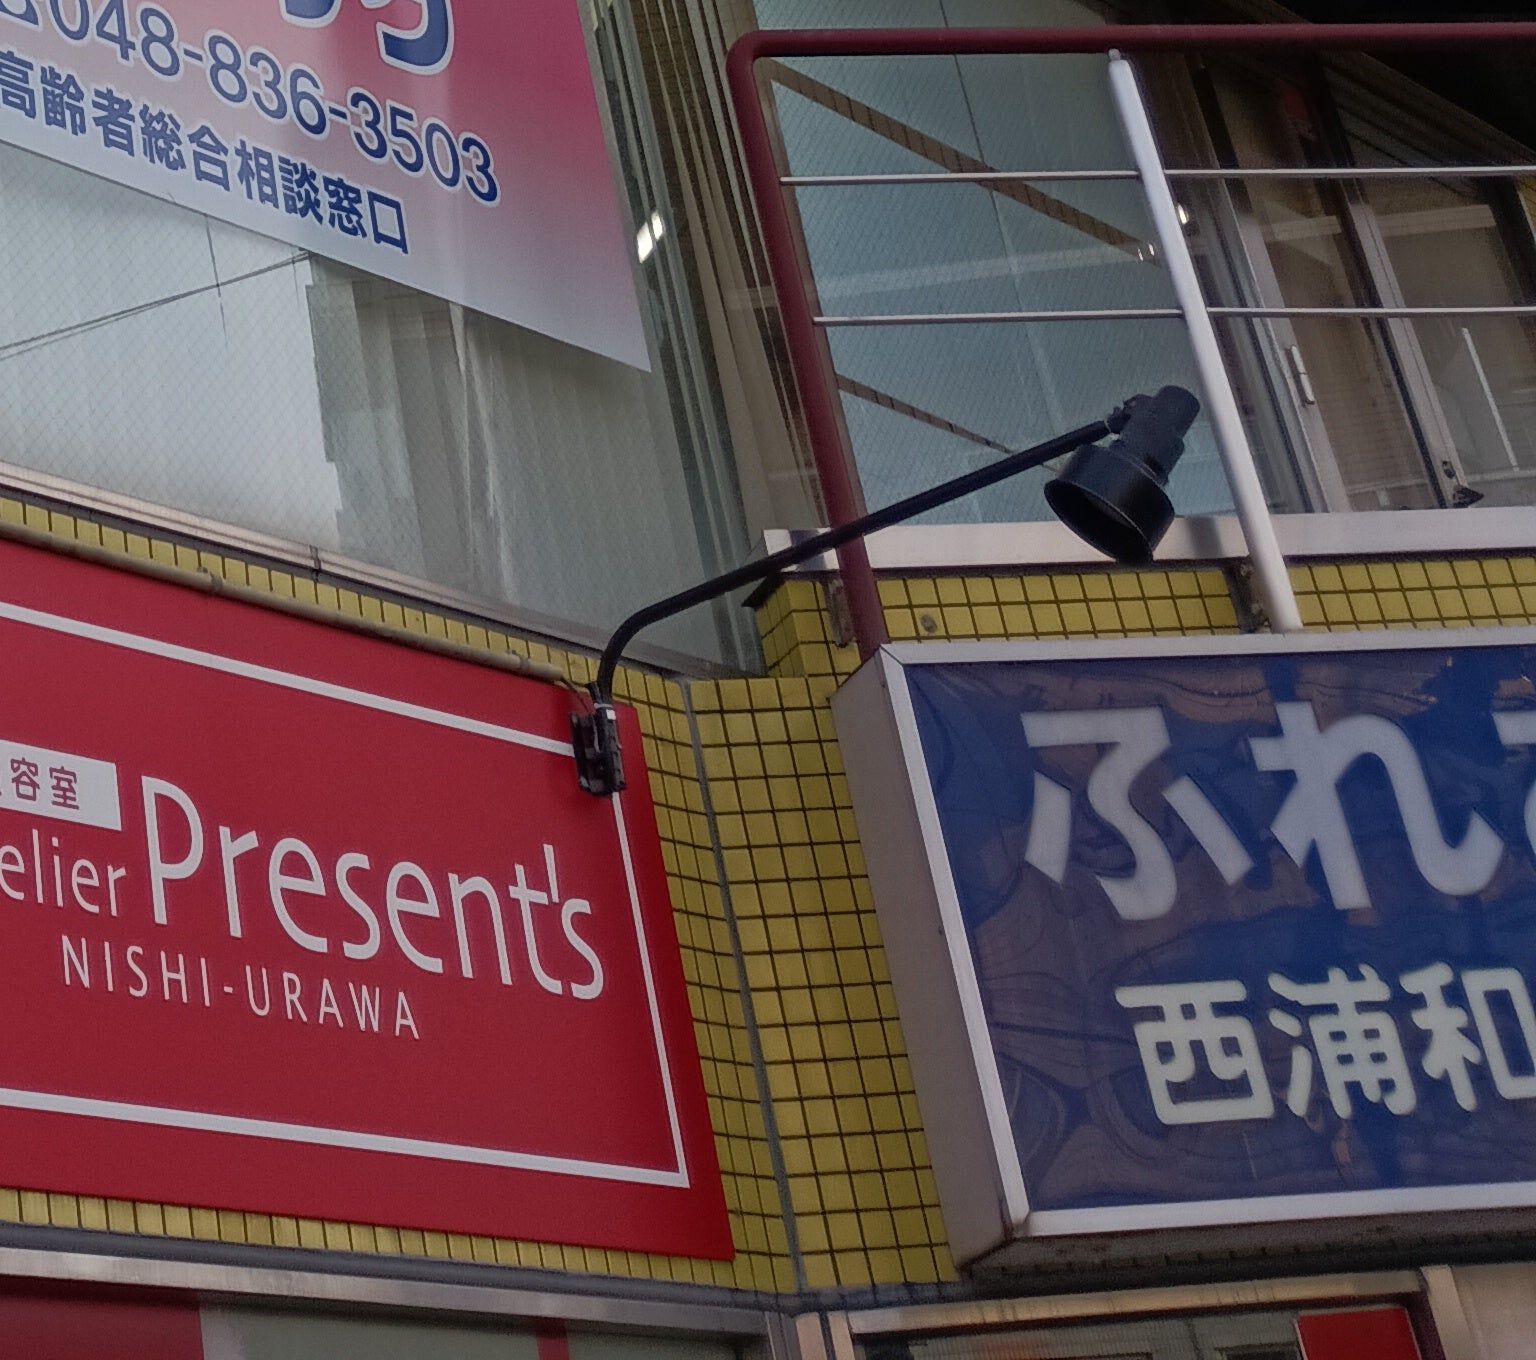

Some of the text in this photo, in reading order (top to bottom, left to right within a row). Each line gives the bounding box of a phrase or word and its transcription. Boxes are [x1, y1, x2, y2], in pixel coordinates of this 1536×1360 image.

[141, 775, 605, 999] Present's
[1021, 700, 1536, 921] ふれ
[62, 936, 420, 1040] NISHI-URAWA
[1115, 963, 1536, 1125] 西浦和
